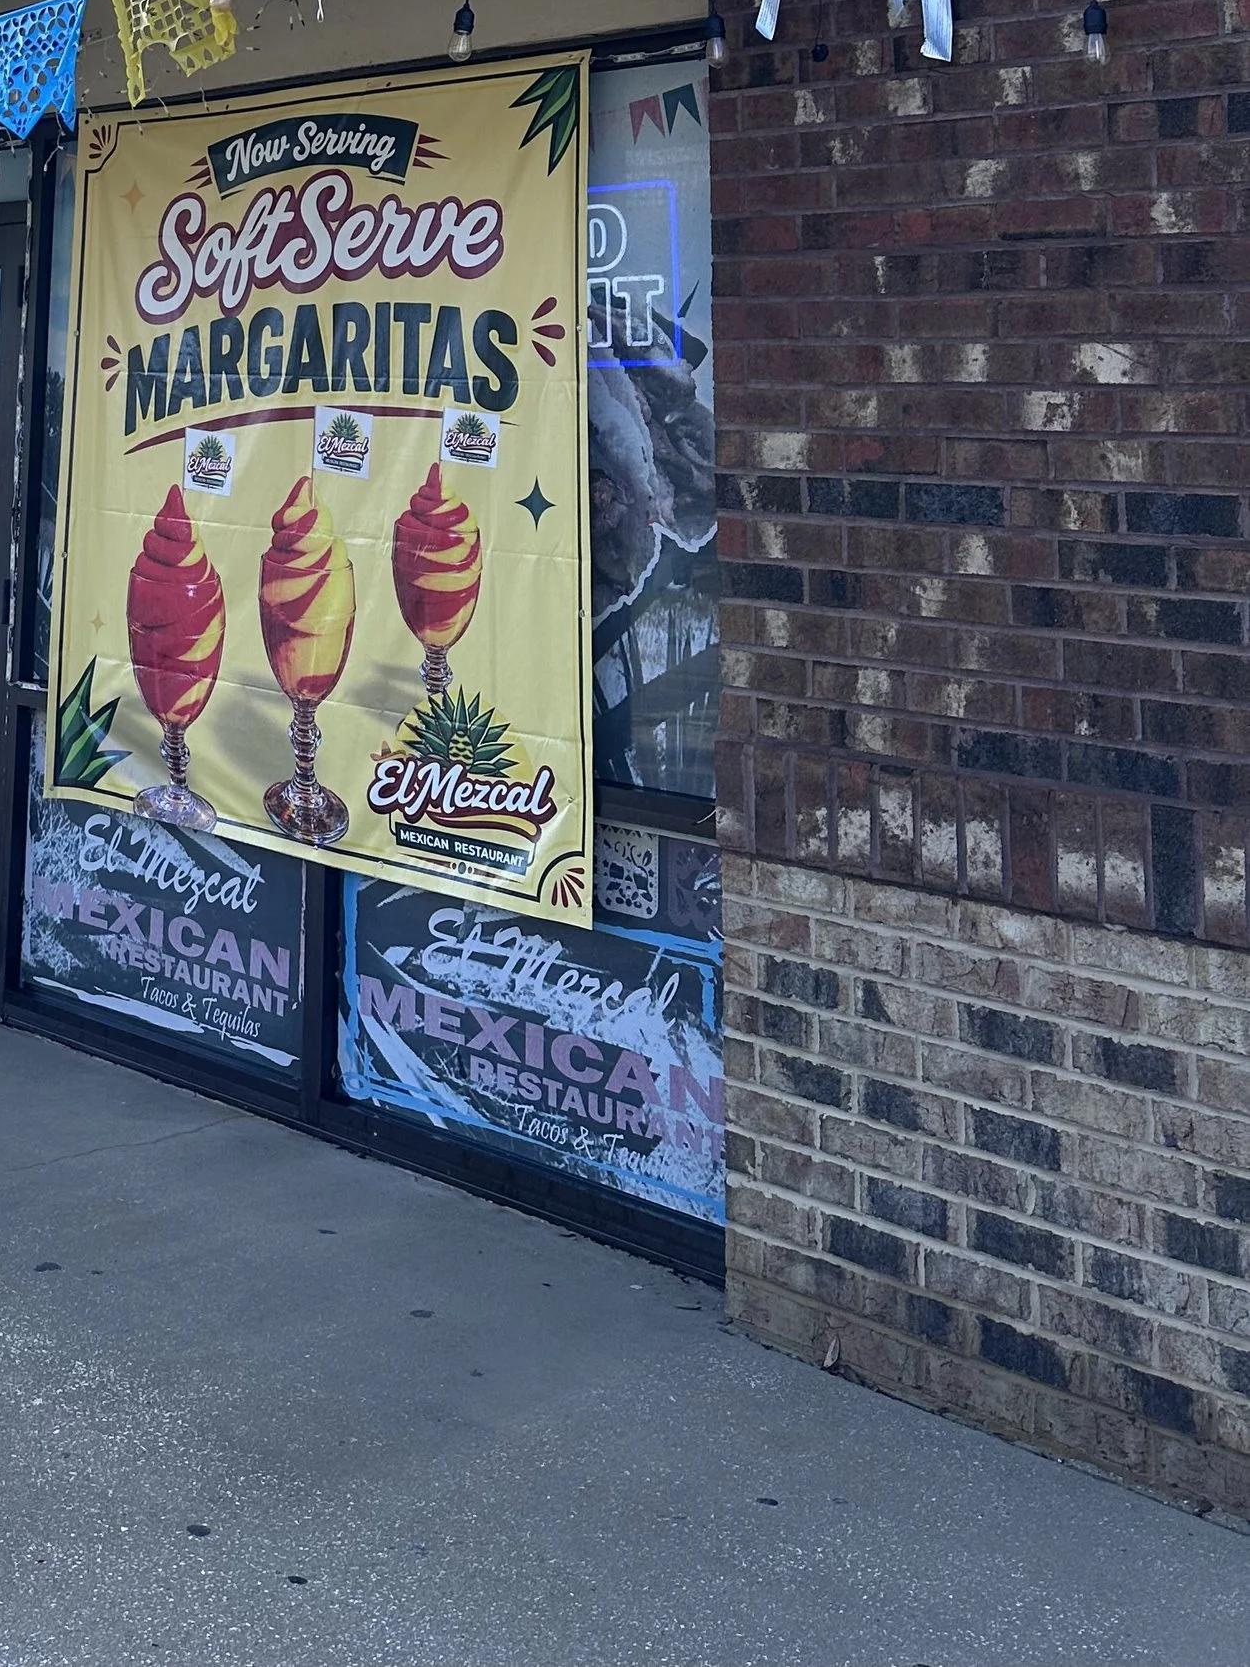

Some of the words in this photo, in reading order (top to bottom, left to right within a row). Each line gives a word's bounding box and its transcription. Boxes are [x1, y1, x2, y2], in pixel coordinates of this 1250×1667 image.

[225, 133, 291, 182] Now
[293, 121, 396, 174] Serving
[124, 301, 519, 436] MARGARITAS
[405, 761, 556, 821] Mezcal
[78, 813, 122, 873] El
[129, 830, 265, 915] Mezcal
[400, 829, 449, 850] MEXICAN
[454, 842, 525, 868] RESTAURANT
[32, 876, 290, 989] MEXICAN
[110, 938, 288, 1017] RESTAURANT
[421, 908, 482, 974] El
[491, 925, 680, 1029] Mezcal
[141, 976, 179, 1009] Tacos
[181, 993, 198, 1022] &
[203, 997, 261, 1040] Tequilas
[359, 973, 726, 1126] MEXICAN
[469, 1055, 725, 1163] RESTAURANT
[514, 1104, 569, 1145] Tacos
[574, 1126, 596, 1160] &
